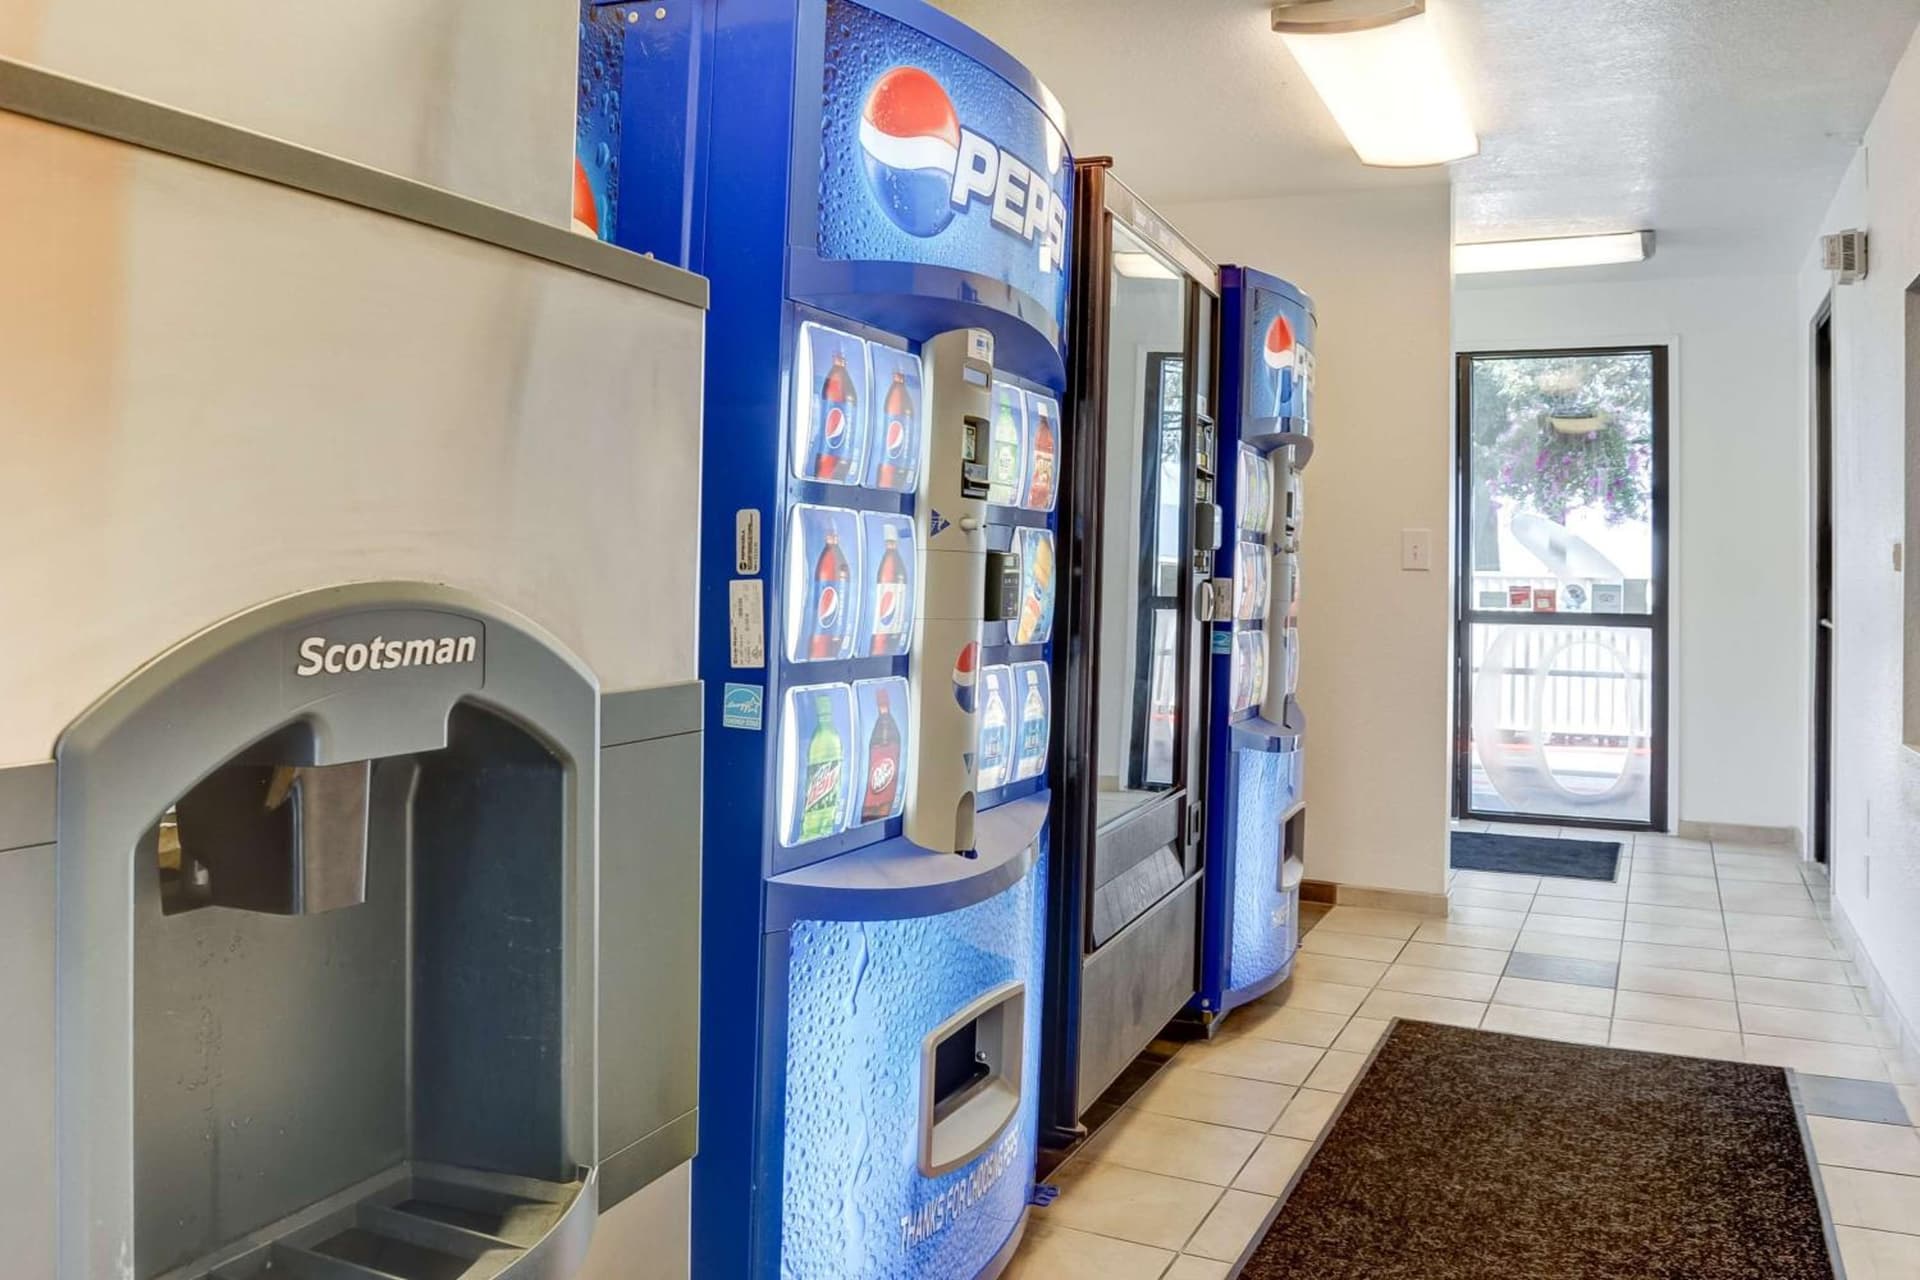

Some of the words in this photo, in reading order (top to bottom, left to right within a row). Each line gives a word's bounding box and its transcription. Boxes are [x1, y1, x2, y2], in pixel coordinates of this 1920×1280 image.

[297, 635, 476, 676] Scotsman
[899, 1192, 946, 1257] THANKS
[945, 1178, 967, 1223] FOR
